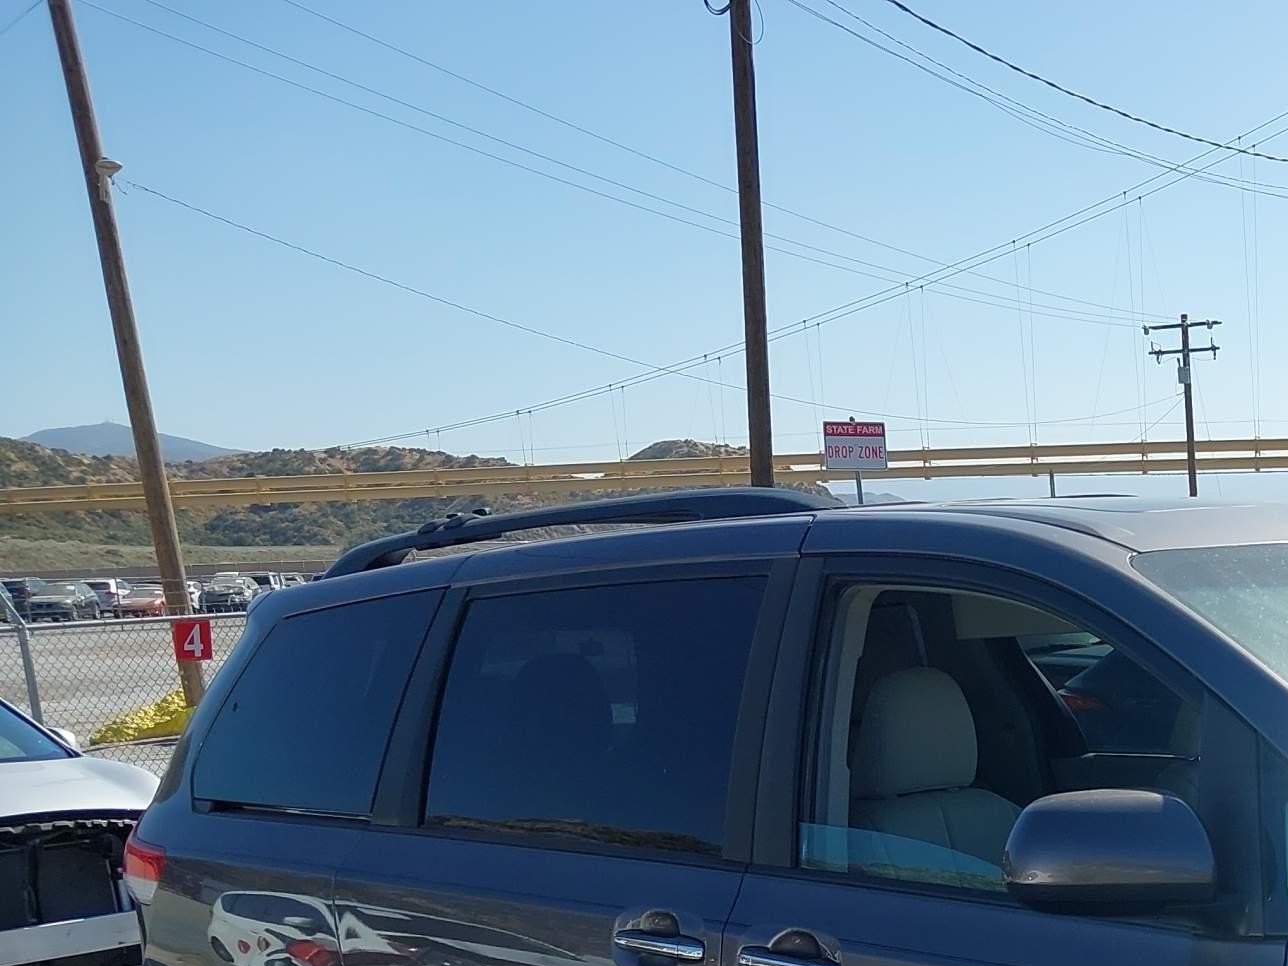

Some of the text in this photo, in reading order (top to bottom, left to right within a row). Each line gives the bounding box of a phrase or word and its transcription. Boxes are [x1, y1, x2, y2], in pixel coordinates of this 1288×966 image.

[826, 425, 883, 434] STATE FARM
[827, 445, 885, 459] DROP ZONE
[183, 623, 205, 657] 4
